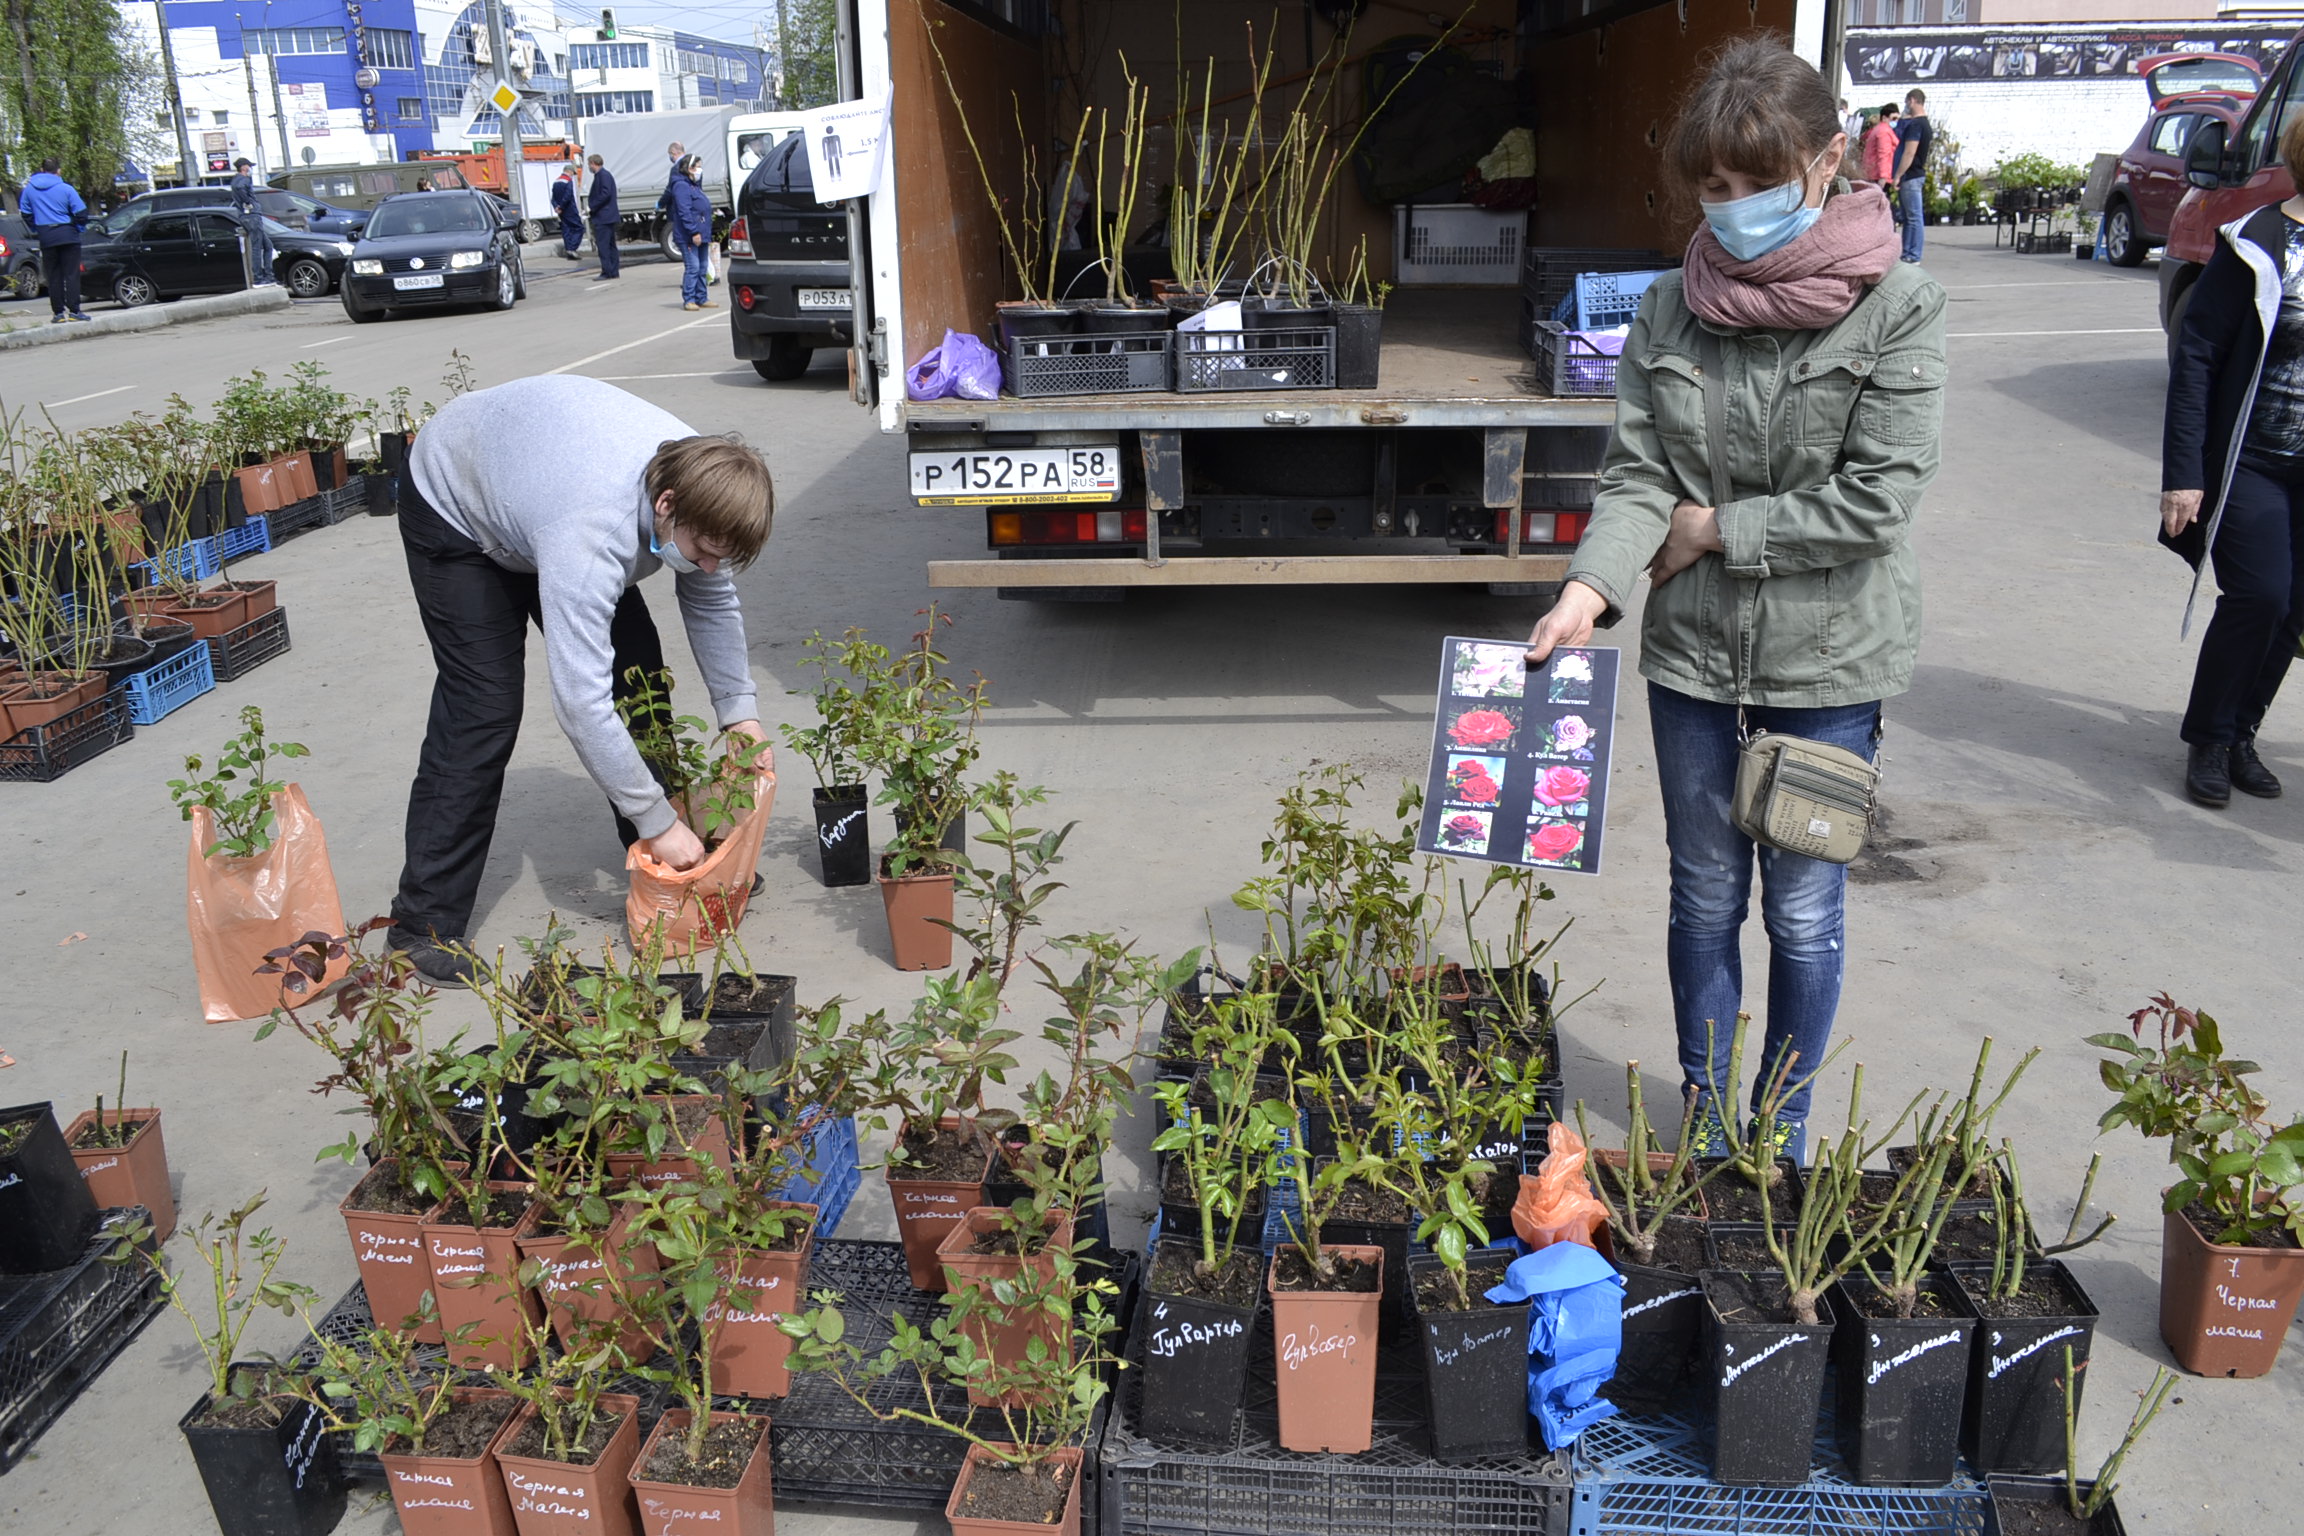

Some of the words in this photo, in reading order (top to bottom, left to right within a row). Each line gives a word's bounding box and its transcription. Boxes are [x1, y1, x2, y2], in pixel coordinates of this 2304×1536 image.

[1983, 36, 2033, 44] АВТОЧЕХЛЫ
[2036, 36, 2043, 44] И
[2045, 35, 2107, 43] АВТОКОВРИКИ
[2109, 34, 2141, 42] КЛАССА
[1072, 452, 1104, 477] 58
[1071, 478, 1095, 488] RUS
